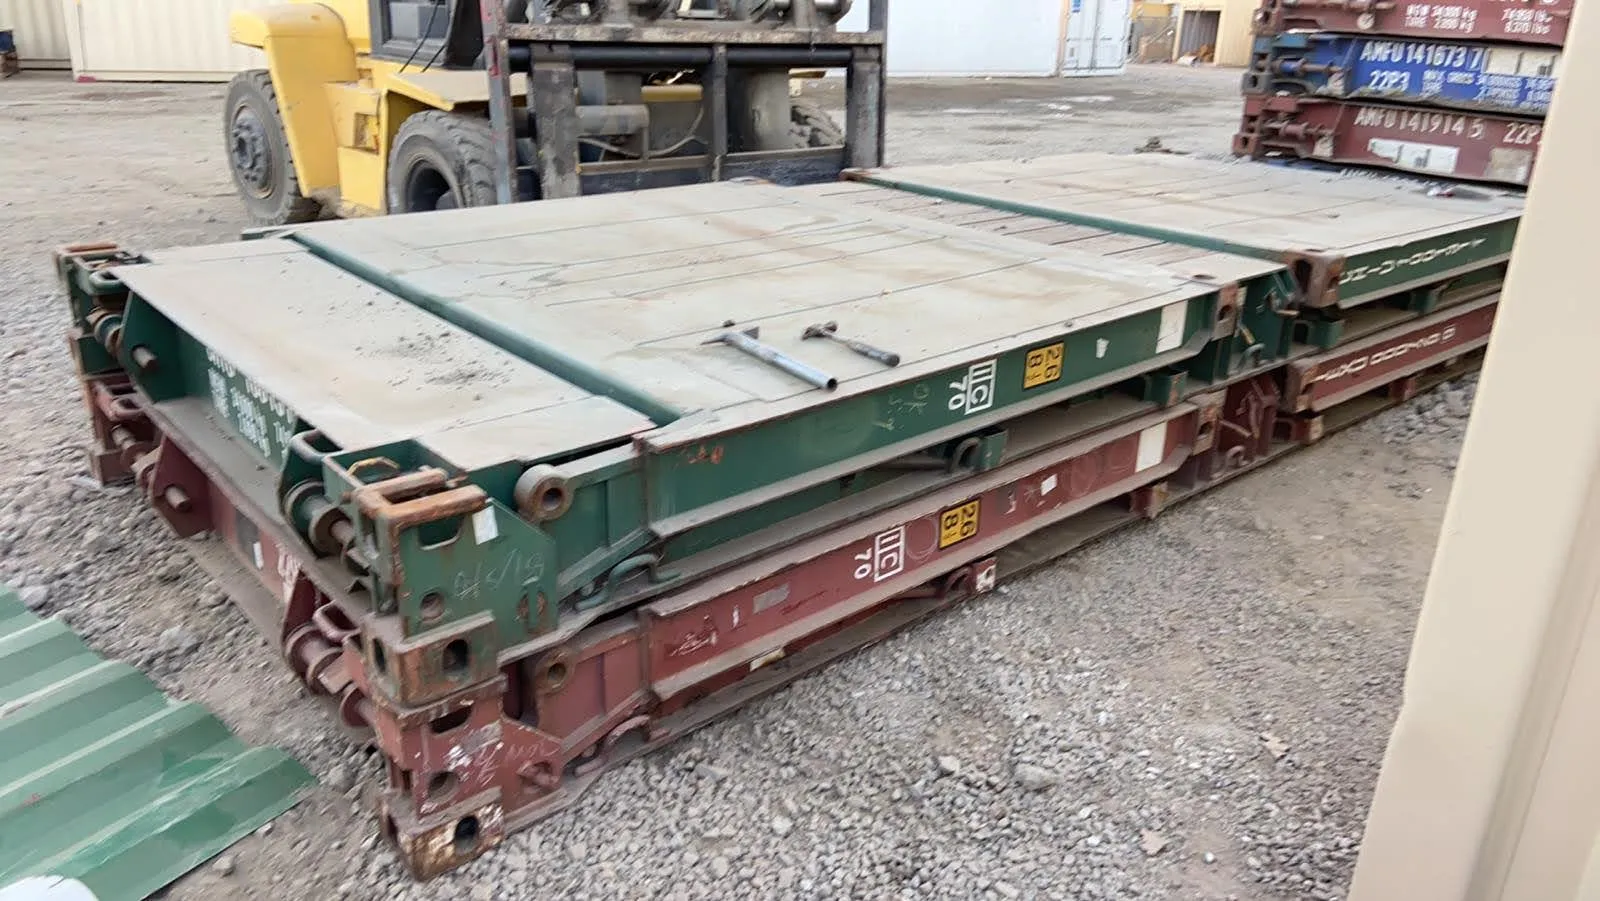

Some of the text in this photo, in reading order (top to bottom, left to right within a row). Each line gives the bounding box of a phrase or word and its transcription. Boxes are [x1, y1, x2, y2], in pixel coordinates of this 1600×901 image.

[1360, 41, 1483, 69] AMFU 141673 7
[1368, 69, 1410, 92] 22P3
[1354, 107, 1397, 129] AMFU
[1399, 109, 1466, 136] 141914
[1502, 122, 1543, 146] 22P
[948, 375, 968, 410] 70
[854, 547, 872, 579] 70
